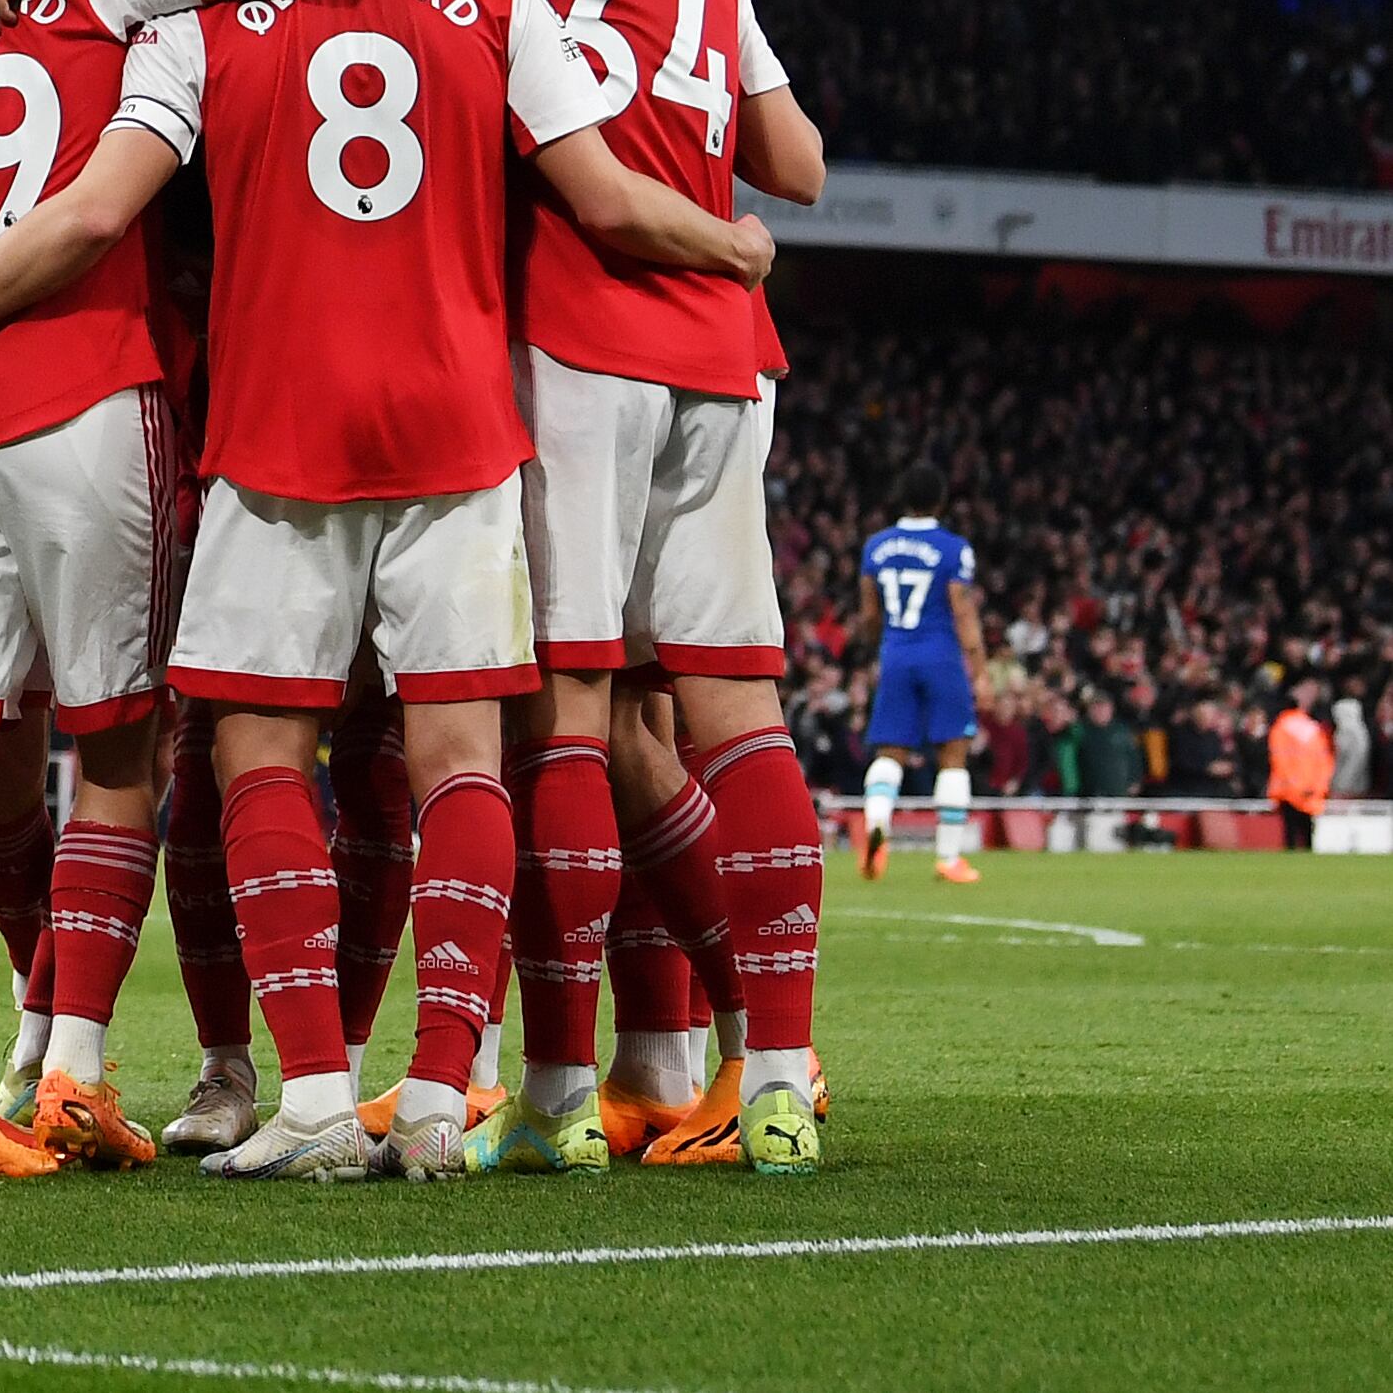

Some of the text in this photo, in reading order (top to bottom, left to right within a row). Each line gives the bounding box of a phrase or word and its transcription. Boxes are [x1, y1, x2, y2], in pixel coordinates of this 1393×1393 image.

[307, 32, 424, 221] 8
[1264, 205, 1393, 263] Emirat
[877, 567, 934, 629] 17
[418, 957, 480, 975] adidas
